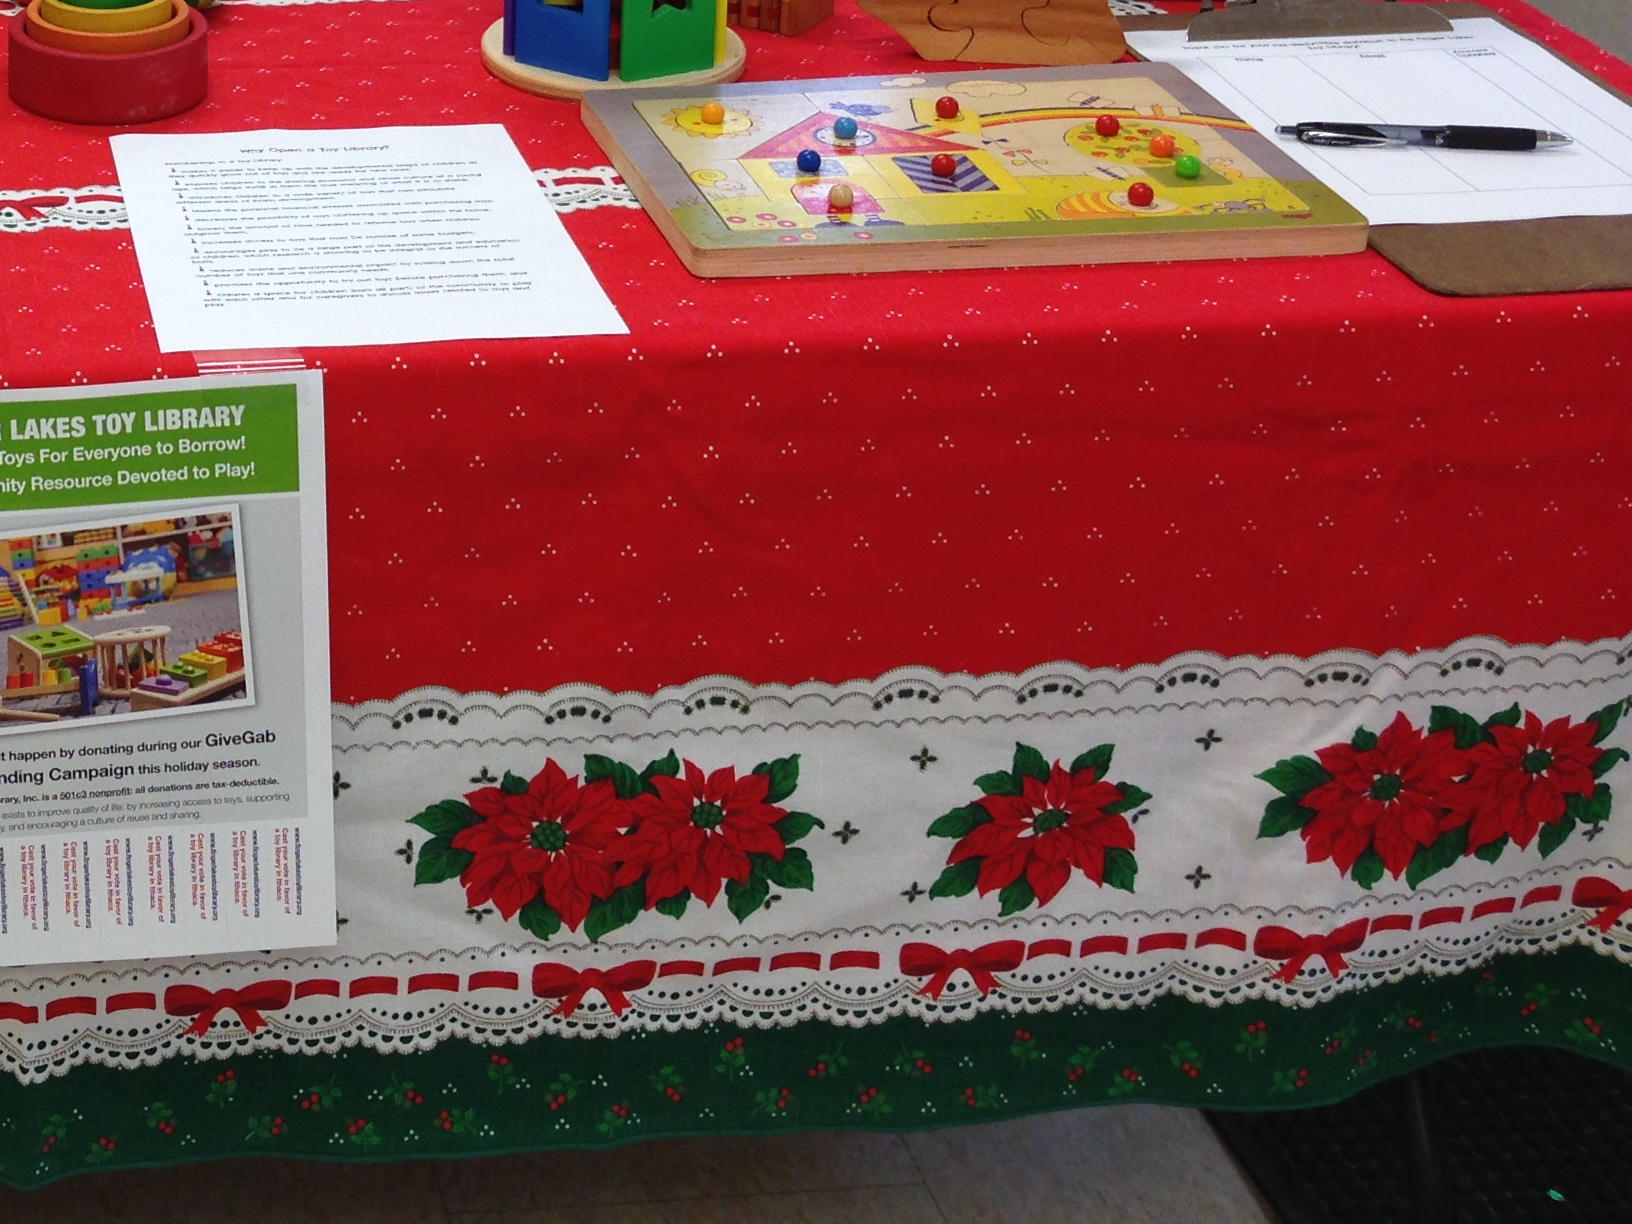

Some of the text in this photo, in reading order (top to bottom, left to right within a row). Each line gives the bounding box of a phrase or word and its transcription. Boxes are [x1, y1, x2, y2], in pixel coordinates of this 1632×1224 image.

[10, 416, 87, 441] LAKES
[92, 411, 137, 436] TOY
[144, 404, 246, 432] LIBRARY
[39, 448, 68, 464] For
[72, 444, 152, 462] Everyone
[155, 441, 173, 455] to
[178, 435, 246, 454] Borrow!
[31, 474, 113, 491] Resource
[117, 466, 188, 486] Devoted
[192, 465, 210, 479] to
[214, 462, 256, 481] Play!
[8, 749, 56, 763] happen
[59, 747, 75, 760] by
[77, 743, 134, 757] donating
[136, 740, 177, 753] during
[180, 739, 202, 749] our
[205, 729, 277, 747] GiveGab
[48, 763, 135, 782] Campaign
[138, 763, 161, 775] this
[164, 760, 210, 774] holiday
[212, 757, 261, 770] season.
[42, 793, 50, 801] is
[135, 785, 146, 794] all
[147, 783, 193, 793] donations
[195, 782, 210, 790] are
